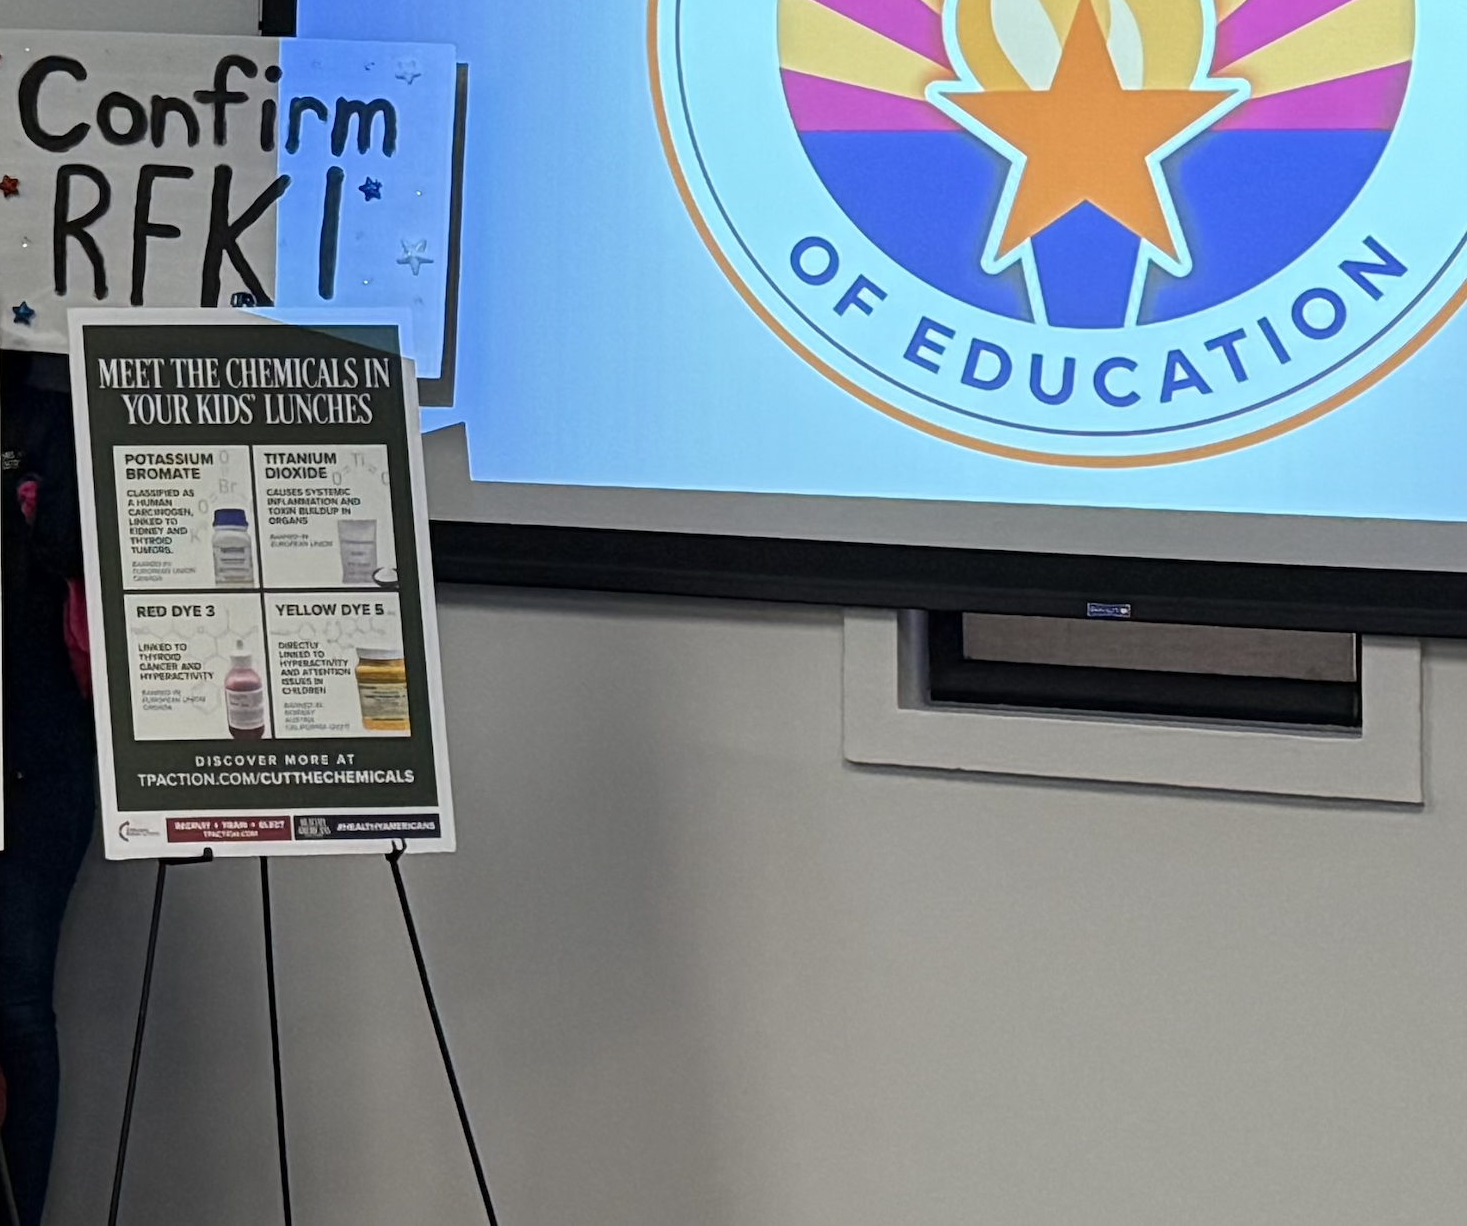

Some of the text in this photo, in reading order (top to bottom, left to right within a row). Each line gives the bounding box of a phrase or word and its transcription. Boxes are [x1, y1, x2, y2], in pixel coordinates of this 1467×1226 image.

[19, 54, 398, 157] Confirm
[789, 234, 1410, 409] OF EDUCATION
[98, 357, 390, 389] MEET THE CHEMICALS IN
[121, 394, 192, 425] YOUR
[264, 393, 373, 424] LUNCHES
[125, 453, 214, 466] POTASSIUM
[264, 452, 337, 465] TITANIUM
[126, 468, 201, 480] BROMATE
[265, 467, 328, 479] DIOXIDE
[127, 489, 195, 498] CLASSIFIED AS
[266, 488, 351, 496] CAUSES SYSTEMIC
[127, 499, 173, 507] A HUMAN
[267, 497, 361, 506] INFLAMMATION AND
[268, 507, 296, 515] TOXIN
[342, 507, 351, 515] IN
[129, 518, 163, 526] LINKED
[268, 517, 308, 525] ORGANS
[166, 527, 188, 535] AND
[130, 537, 173, 545] THYROID
[136, 605, 215, 617] RED DYE 3
[275, 604, 385, 616] YELLOW DYE 5
[138, 643, 187, 651] LINKED TO
[313, 650, 325, 658] TO
[140, 662, 201, 671] CANCER AND
[280, 659, 348, 667] HYPERACTIVITY
[140, 672, 214, 680] HYPERACTIVITY
[281, 668, 351, 676] AND ATTENTION
[195, 754, 356, 767] DISCOVER MORE AT
[138, 770, 415, 787] TPACTION.COM/CUTTHECHEMICALS
